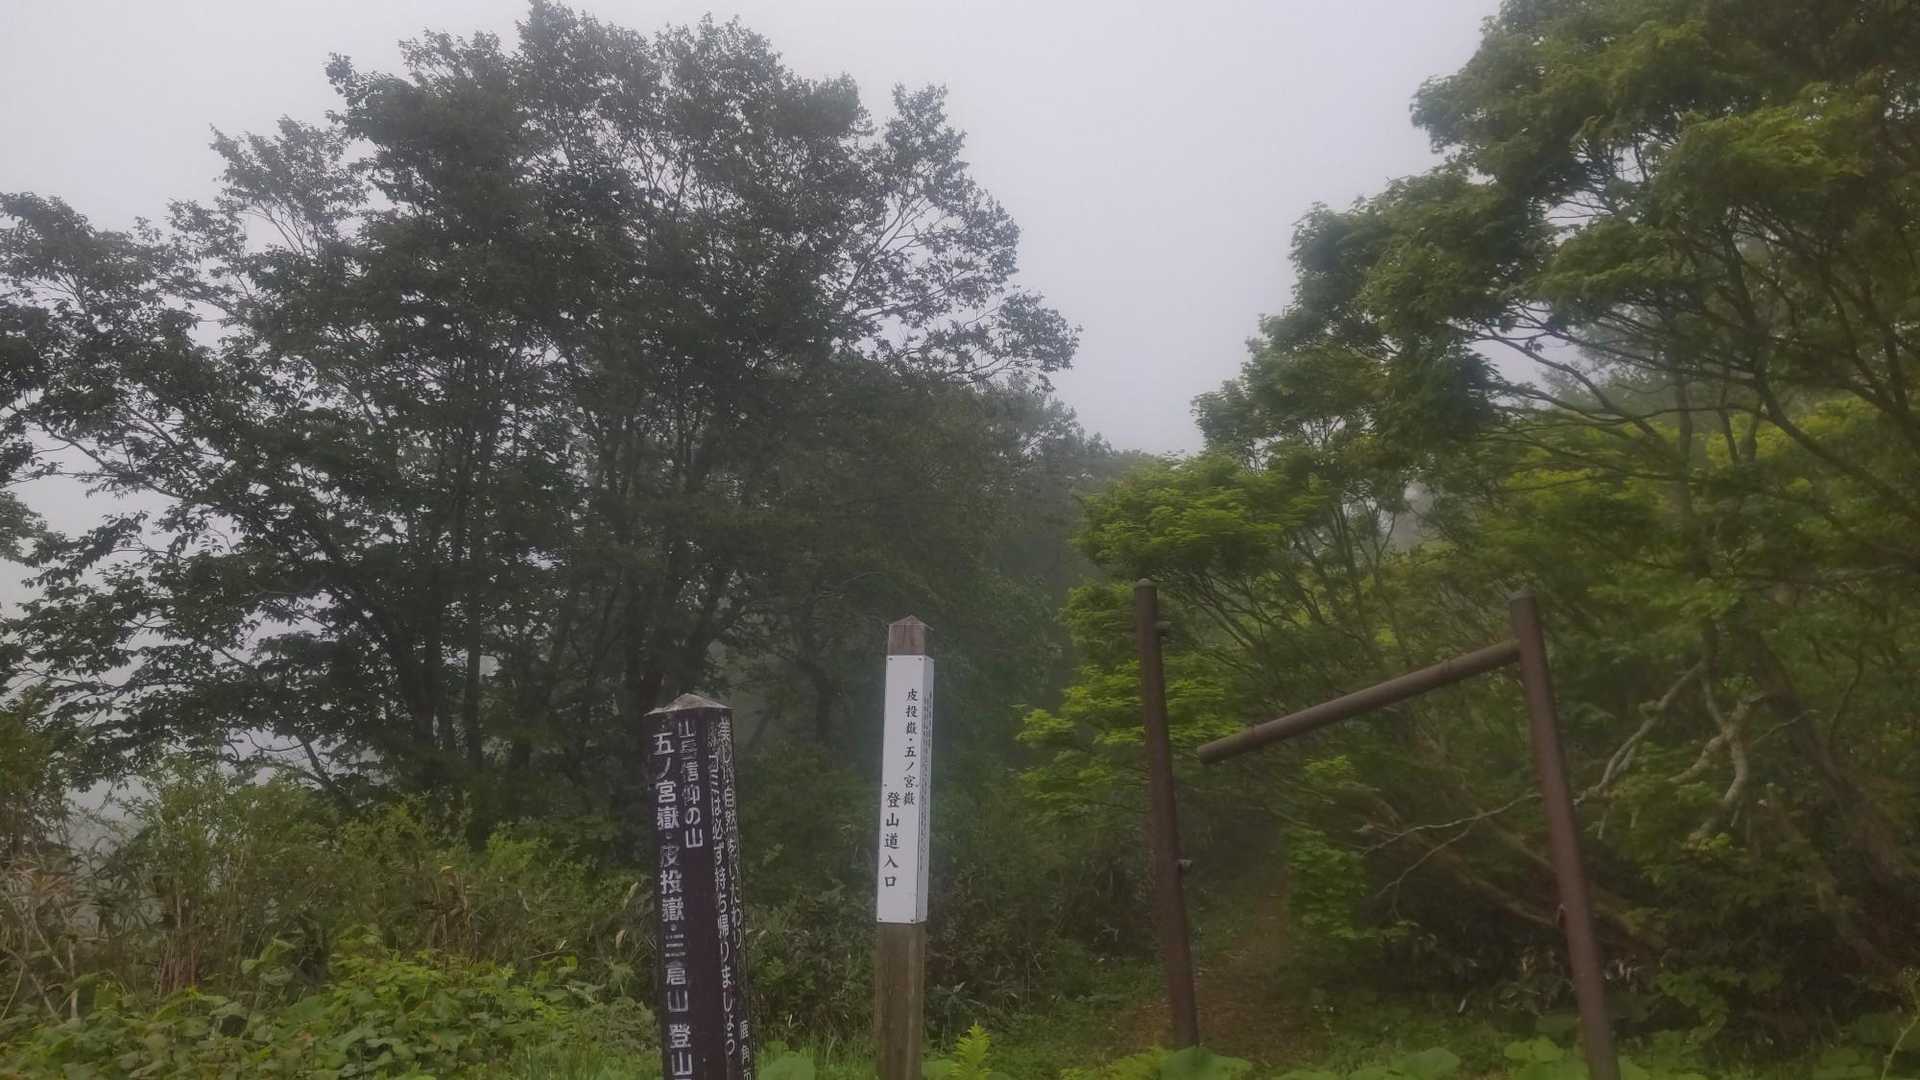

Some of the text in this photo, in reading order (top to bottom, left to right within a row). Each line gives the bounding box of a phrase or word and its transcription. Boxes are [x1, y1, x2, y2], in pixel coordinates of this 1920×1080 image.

[652, 732, 693, 1080] 五ノ宮嶽・皮投嶽・三倉山登山
[707, 721, 736, 1055] ゴミは必ず持ち帰りましょう
[884, 791, 900, 887] 登山道入口
